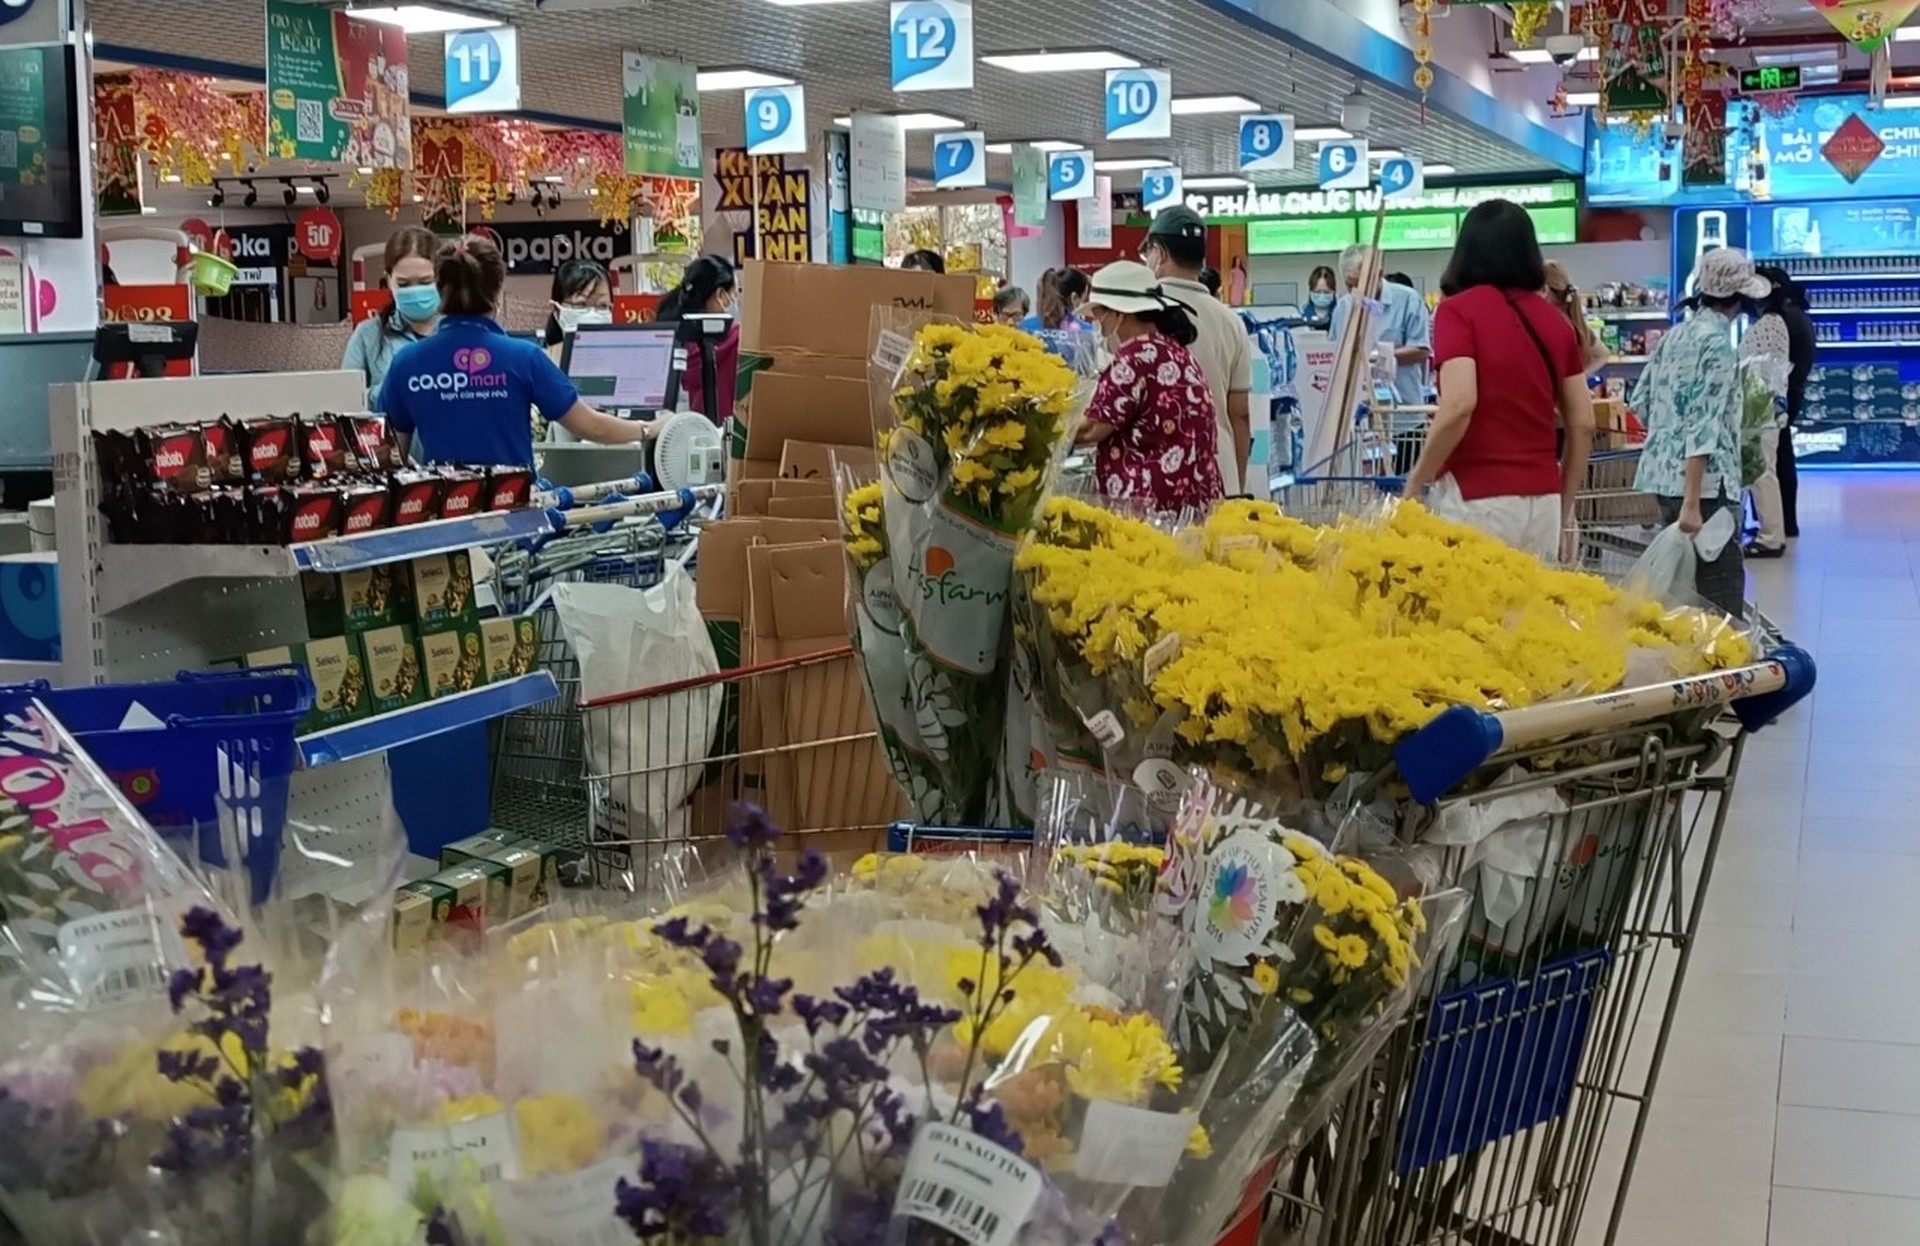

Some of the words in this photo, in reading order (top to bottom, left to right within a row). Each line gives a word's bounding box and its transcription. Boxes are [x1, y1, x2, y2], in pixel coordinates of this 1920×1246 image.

[898, 16, 946, 59] 12
[453, 43, 490, 82] 11
[1112, 82, 1151, 116] 10
[757, 98, 779, 132] 9
[1252, 126, 1271, 151] 8
[945, 142, 964, 168] 7
[1329, 147, 1347, 173] 6
[1060, 160, 1076, 183] 5
[1389, 164, 1405, 185] 4
[722, 167, 807, 207] XUÂN
[1151, 177, 1166, 195] 3
[507, 230, 613, 266] papka
[315, 656, 341, 668] Select
[373, 643, 397, 655] Select
[431, 645, 454, 656] Select
